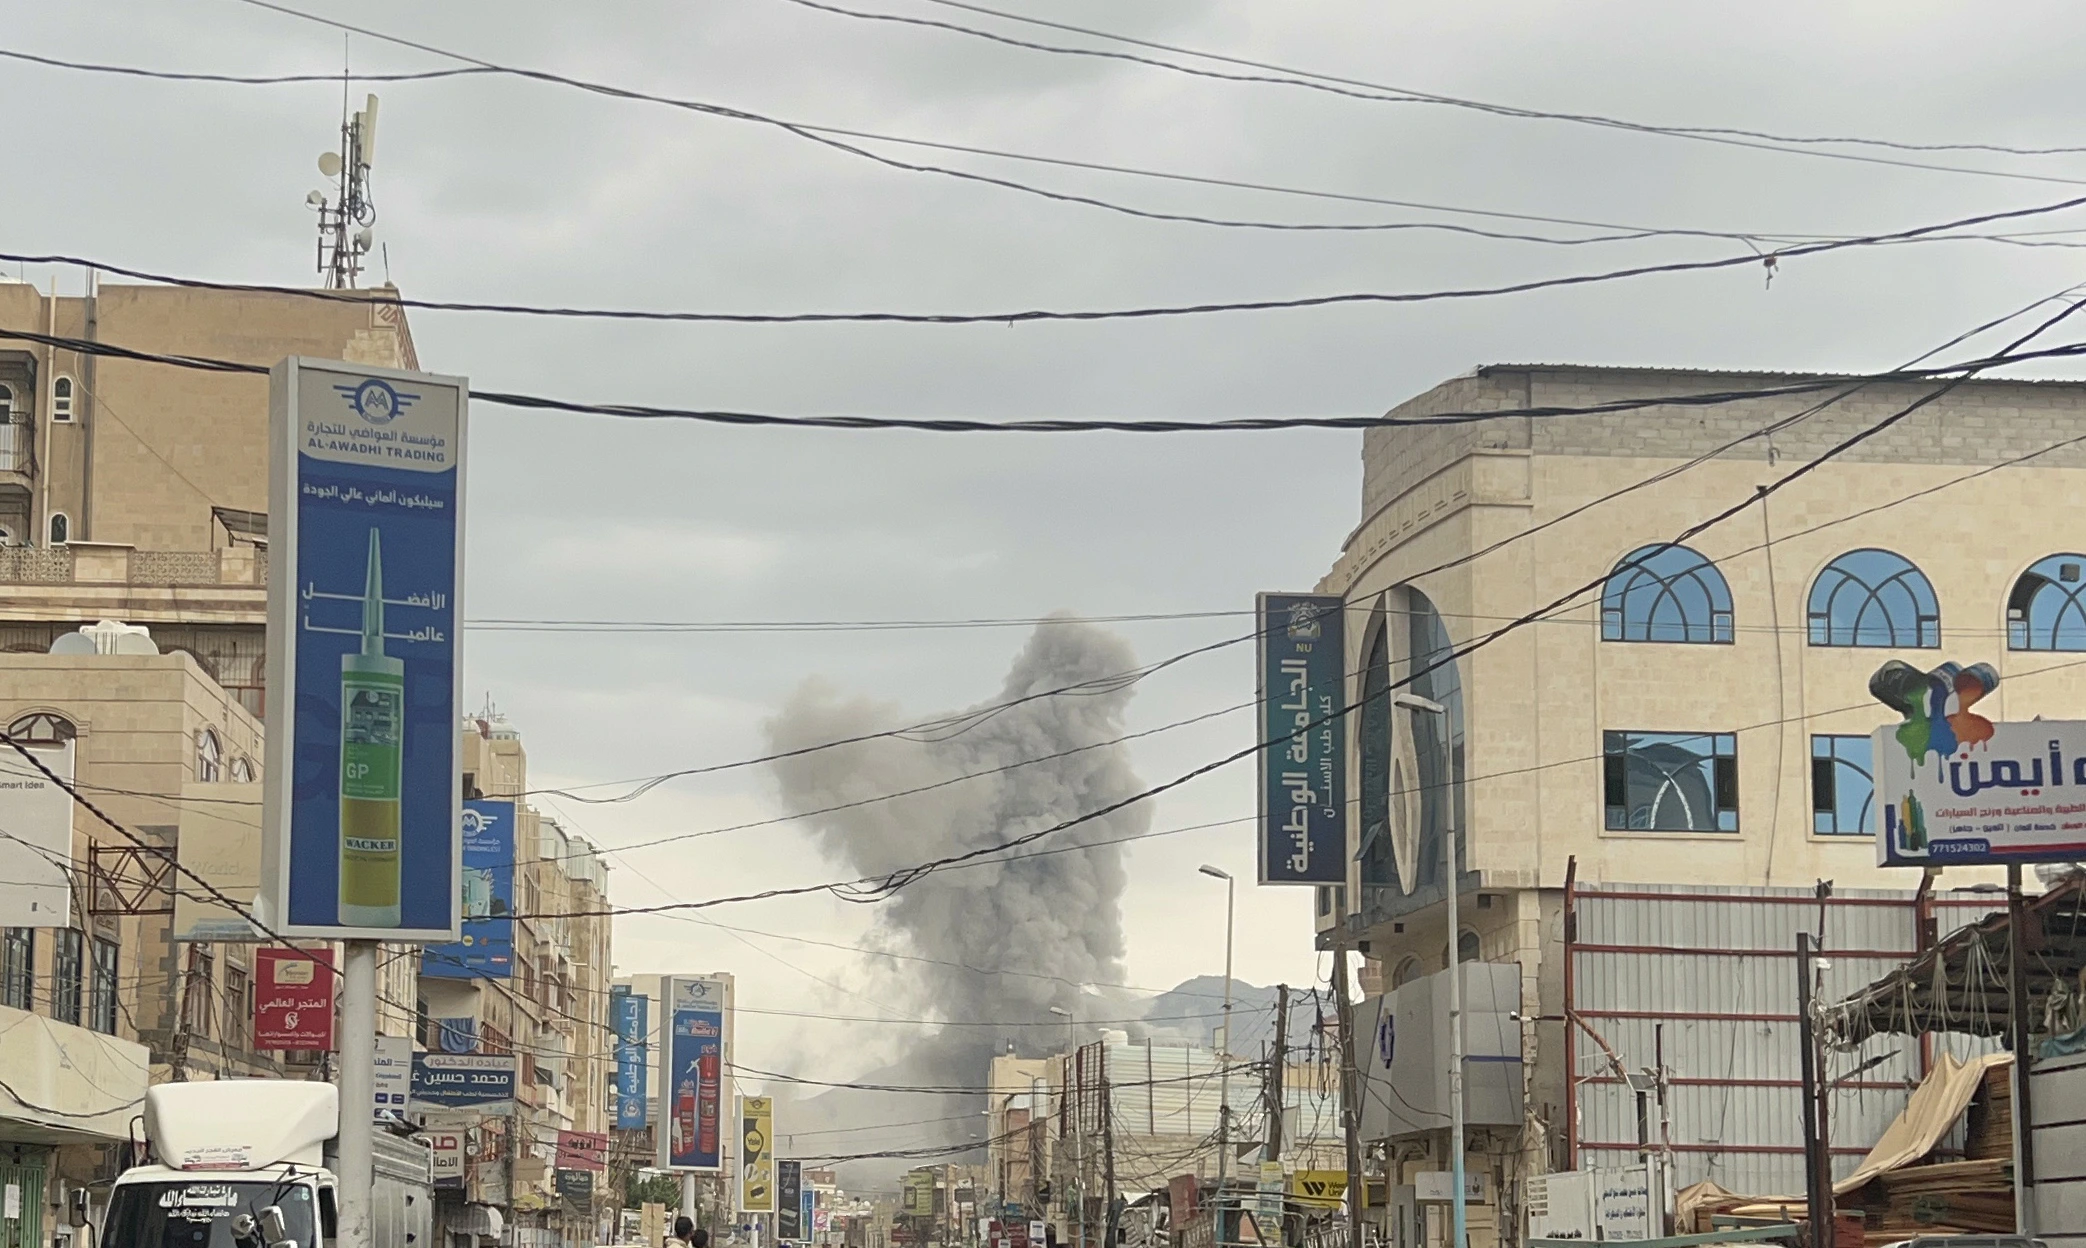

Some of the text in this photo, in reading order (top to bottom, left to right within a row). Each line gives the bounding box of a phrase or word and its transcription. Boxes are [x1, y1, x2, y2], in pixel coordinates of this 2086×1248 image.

[307, 420, 445, 450] مؤسسة العواضي للتجارة
[308, 437, 445, 463] AL-AWADHI TRADING
[303, 483, 339, 499] الجودة
[340, 487, 363, 504] عالي
[398, 493, 444, 509] سيليكون
[1295, 643, 1313, 653] NU
[1319, 729, 1335, 754] طب
[346, 762, 370, 780] GP
[1280, 659, 1317, 873] الجامعة الوطنية
[1949, 739, 2064, 798] أيمن
[1935, 807, 1978, 819] السيارات
[345, 838, 397, 851] WACKER
[258, 998, 327, 1014] المتجر العالمي
[429, 1057, 474, 1067] الدكتور
[424, 1071, 465, 1086] حسين
[470, 1074, 509, 1085] محمد
